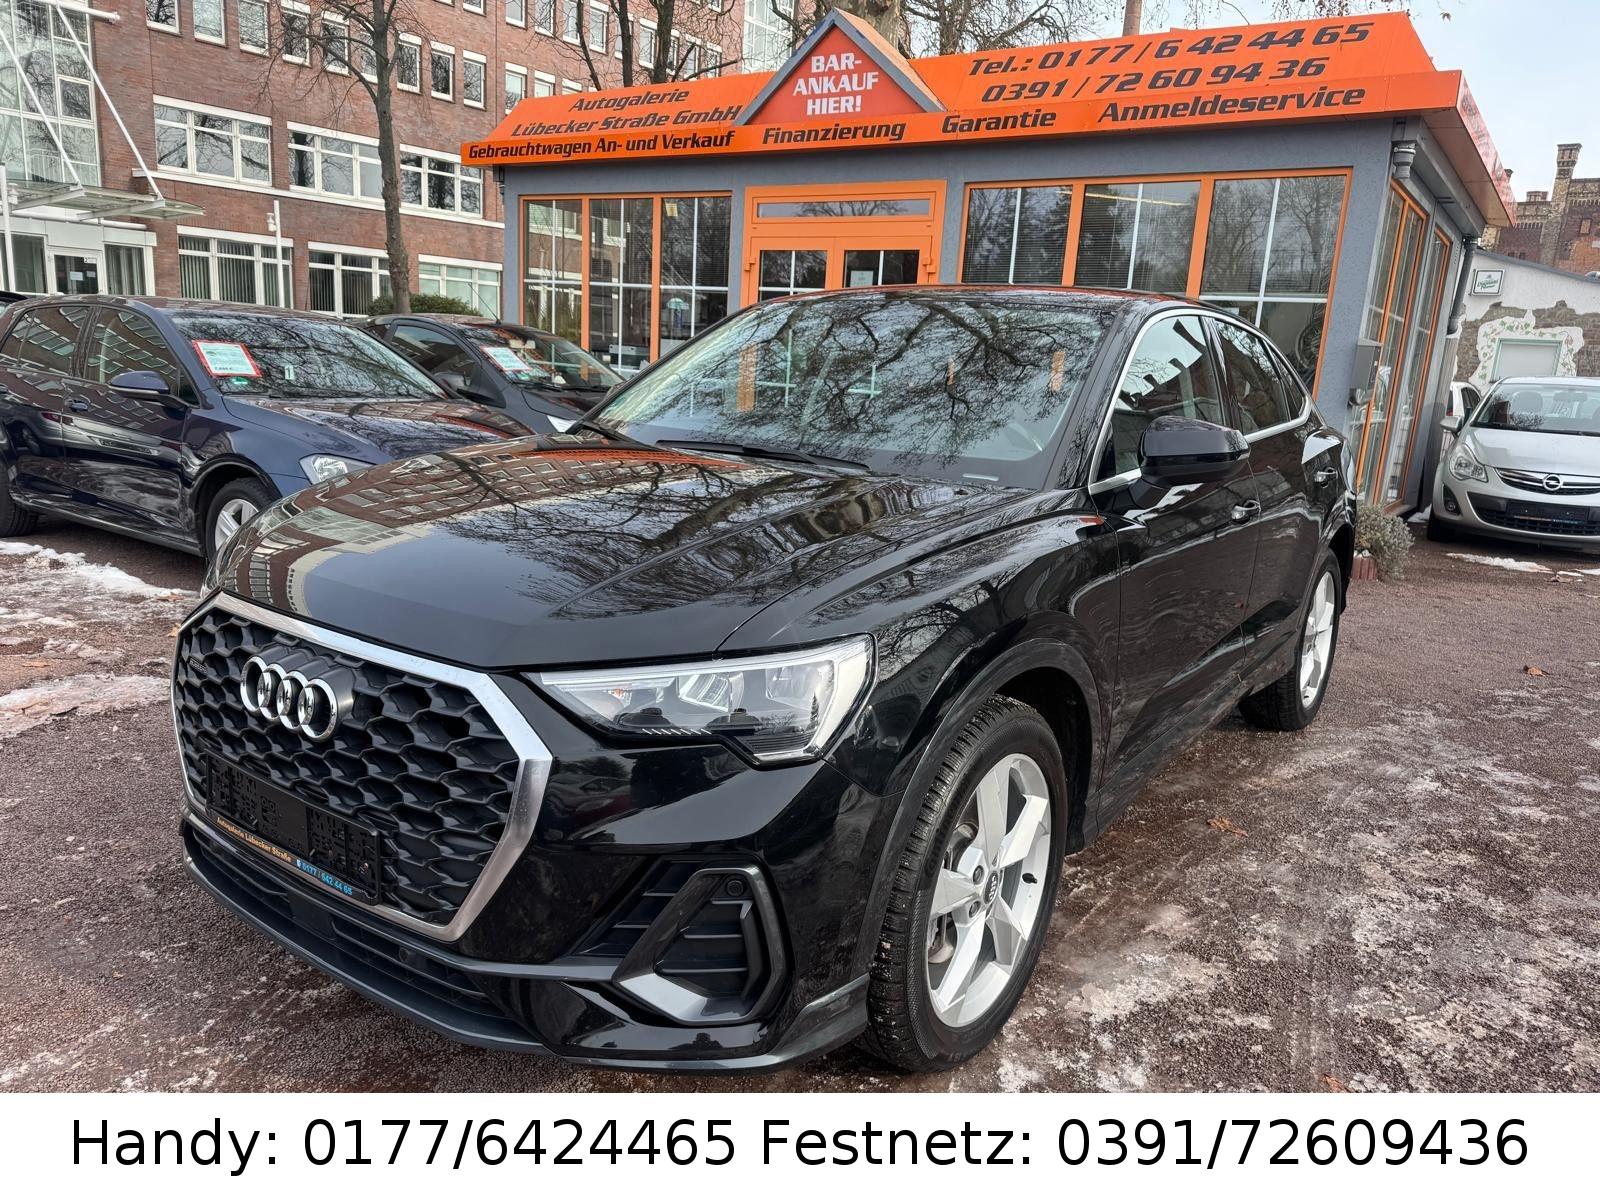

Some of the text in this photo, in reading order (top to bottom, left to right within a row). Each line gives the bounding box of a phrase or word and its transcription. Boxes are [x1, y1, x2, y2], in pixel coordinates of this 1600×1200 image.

[969, 56, 1034, 76] Tel.:
[1187, 34, 1243, 56] 42
[1247, 28, 1306, 50] 44
[1312, 22, 1375, 46] 65
[811, 52, 862, 73] BAR-
[792, 71, 879, 96] ANKAUF
[981, 78, 1070, 103] 0391
[1094, 72, 1144, 94] 72
[1147, 67, 1203, 90] 60
[1206, 61, 1264, 85] 94
[1269, 57, 1330, 80] 36
[568, 88, 690, 112] Autogalerie
[806, 95, 862, 116] HIER!
[1097, 86, 1366, 123] Anmeldeservice
[511, 104, 743, 137] Lübecker Straße GmbH
[762, 122, 907, 145] Finanzierung
[942, 108, 1057, 134] Garantie
[469, 130, 736, 158] Gebrauchtwagen An- und Verkauf
